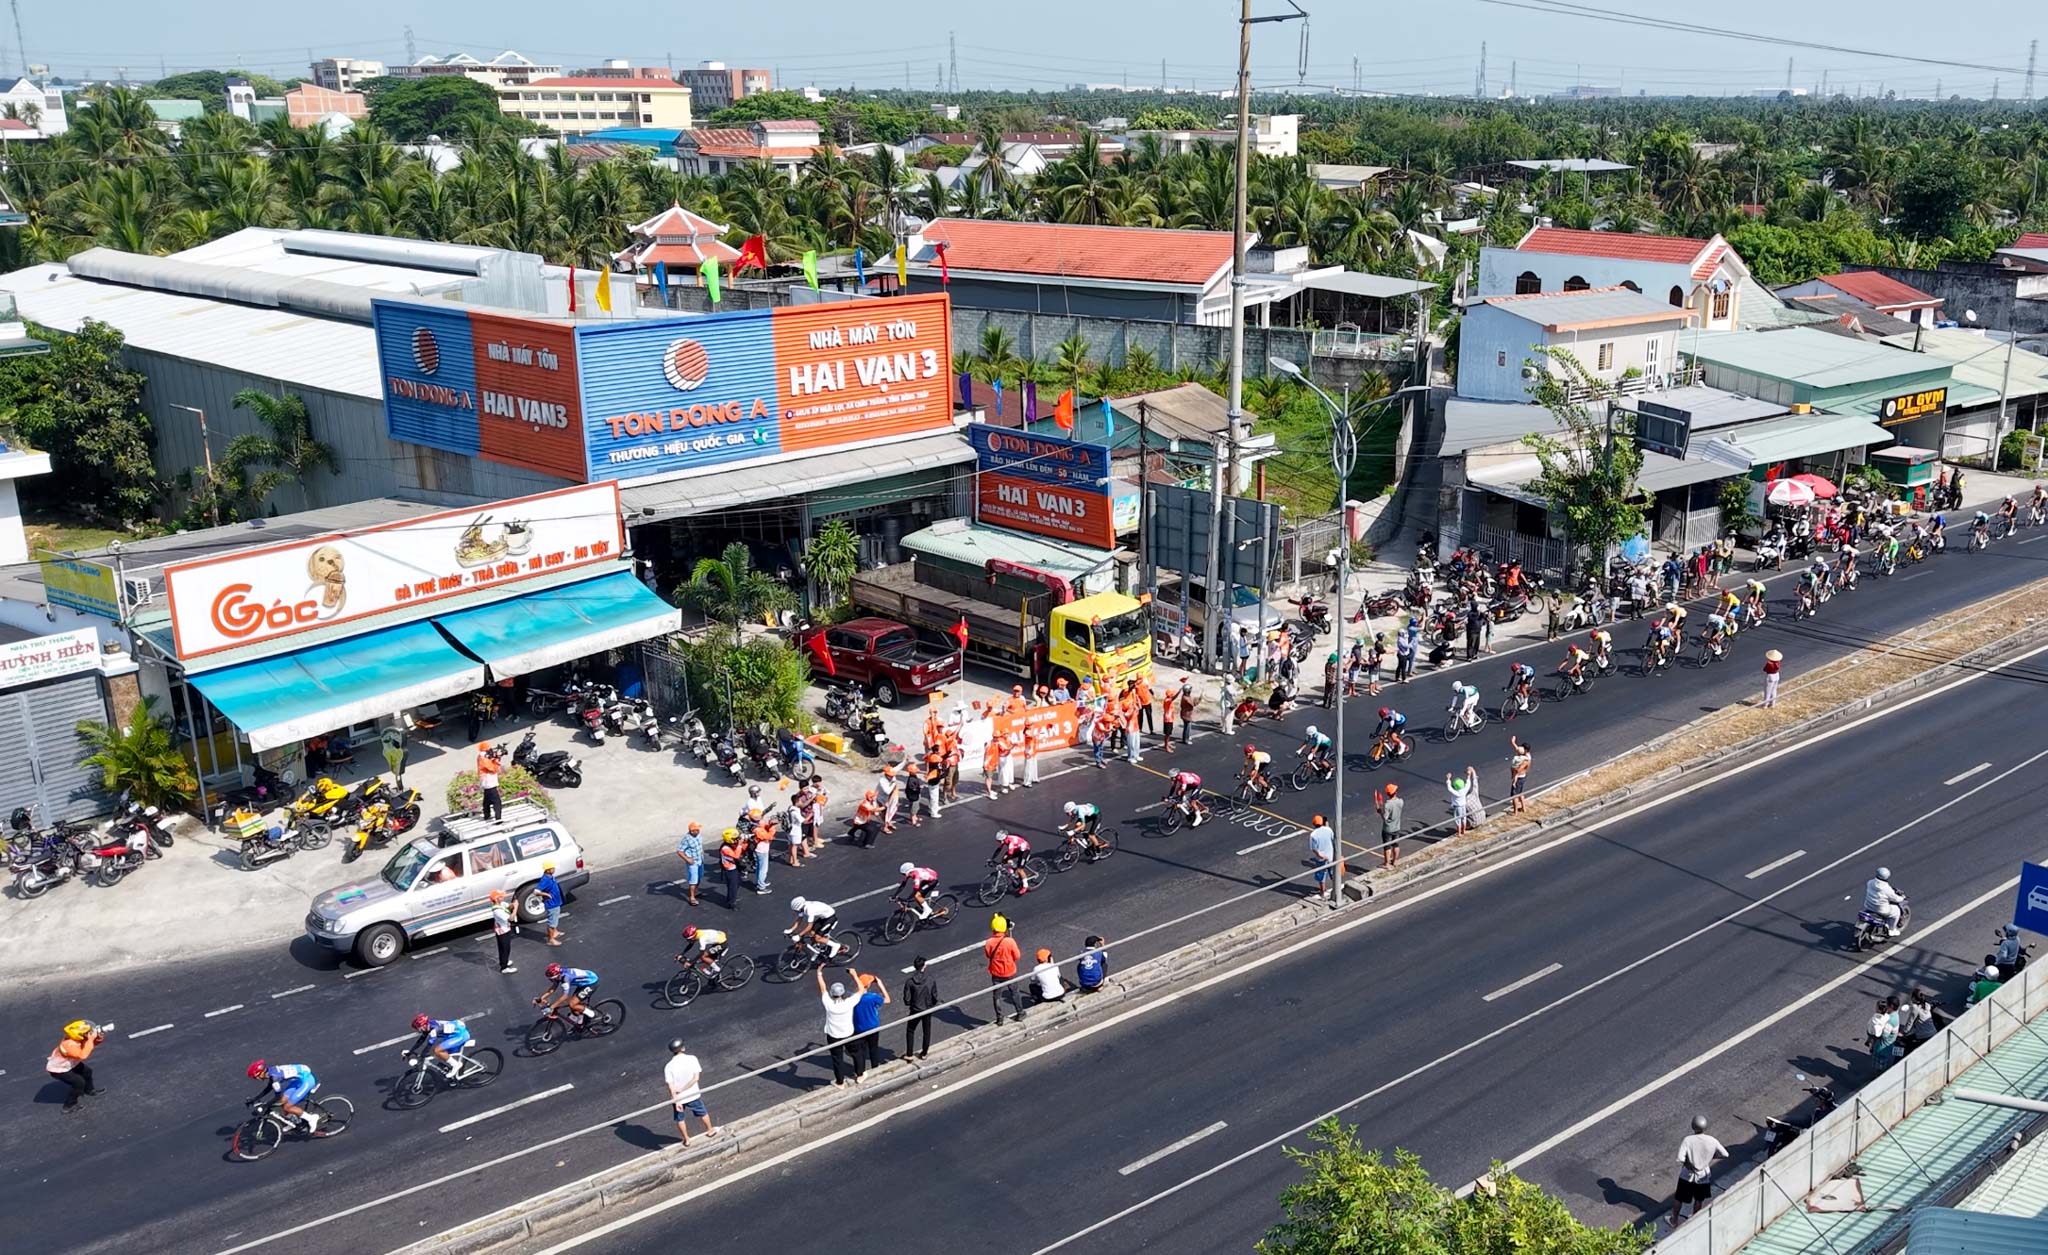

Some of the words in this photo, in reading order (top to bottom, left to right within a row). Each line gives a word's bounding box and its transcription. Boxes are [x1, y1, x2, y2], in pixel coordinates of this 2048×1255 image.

[809, 326, 842, 349] NHÀ
[848, 322, 879, 345] MÁY
[886, 318, 916, 340] TÔN
[488, 340, 510, 362] NHÀ
[512, 344, 532, 366] MÁY
[537, 348, 558, 370] TÔN
[790, 360, 845, 396] HAI
[854, 353, 916, 392] VẠN
[921, 350, 938, 378] 3
[483, 391, 515, 418] HAI
[1897, 396, 1913, 410] DT
[1917, 390, 1944, 405] GYM
[606, 411, 664, 439] TON
[669, 401, 742, 431] DONG
[750, 398, 768, 419] A
[609, 446, 659, 464] THƯƠNG
[664, 443, 688, 456] HIỆU
[693, 432, 722, 450] QUỐC
[727, 433, 746, 445] GIA
[1001, 435, 1030, 453] TON
[999, 484, 1028, 506] HAI
[1036, 492, 1073, 517] VẠN
[1075, 500, 1086, 517] 3
[395, 584, 411, 600] CÀ
[414, 579, 436, 596] PHÊ
[472, 566, 493, 583] TRÀ
[545, 551, 565, 567] CAY
[211, 583, 318, 638] Góc
[1064, 721, 1072, 734] 3
